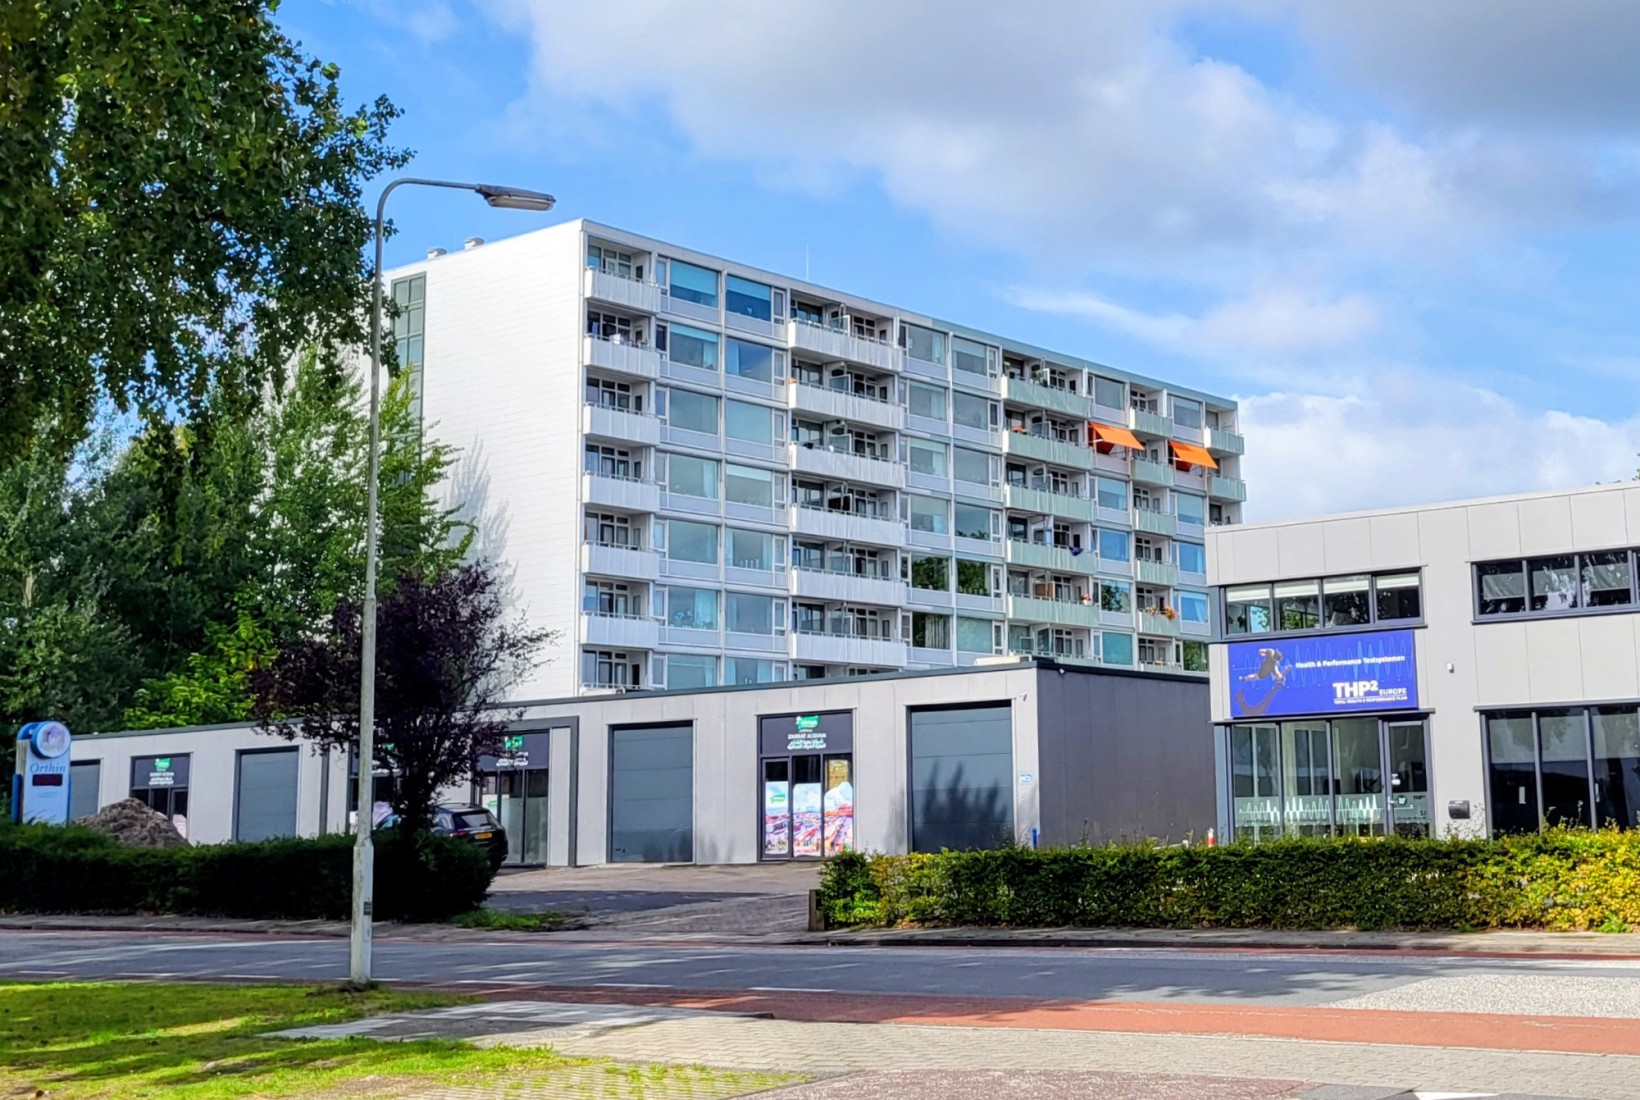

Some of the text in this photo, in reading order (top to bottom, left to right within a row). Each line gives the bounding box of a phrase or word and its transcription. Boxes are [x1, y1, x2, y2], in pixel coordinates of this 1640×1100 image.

[1322, 658, 1362, 667] Performance
[1362, 655, 1405, 664] Testsystemen
[30, 762, 66, 773] Orthin
